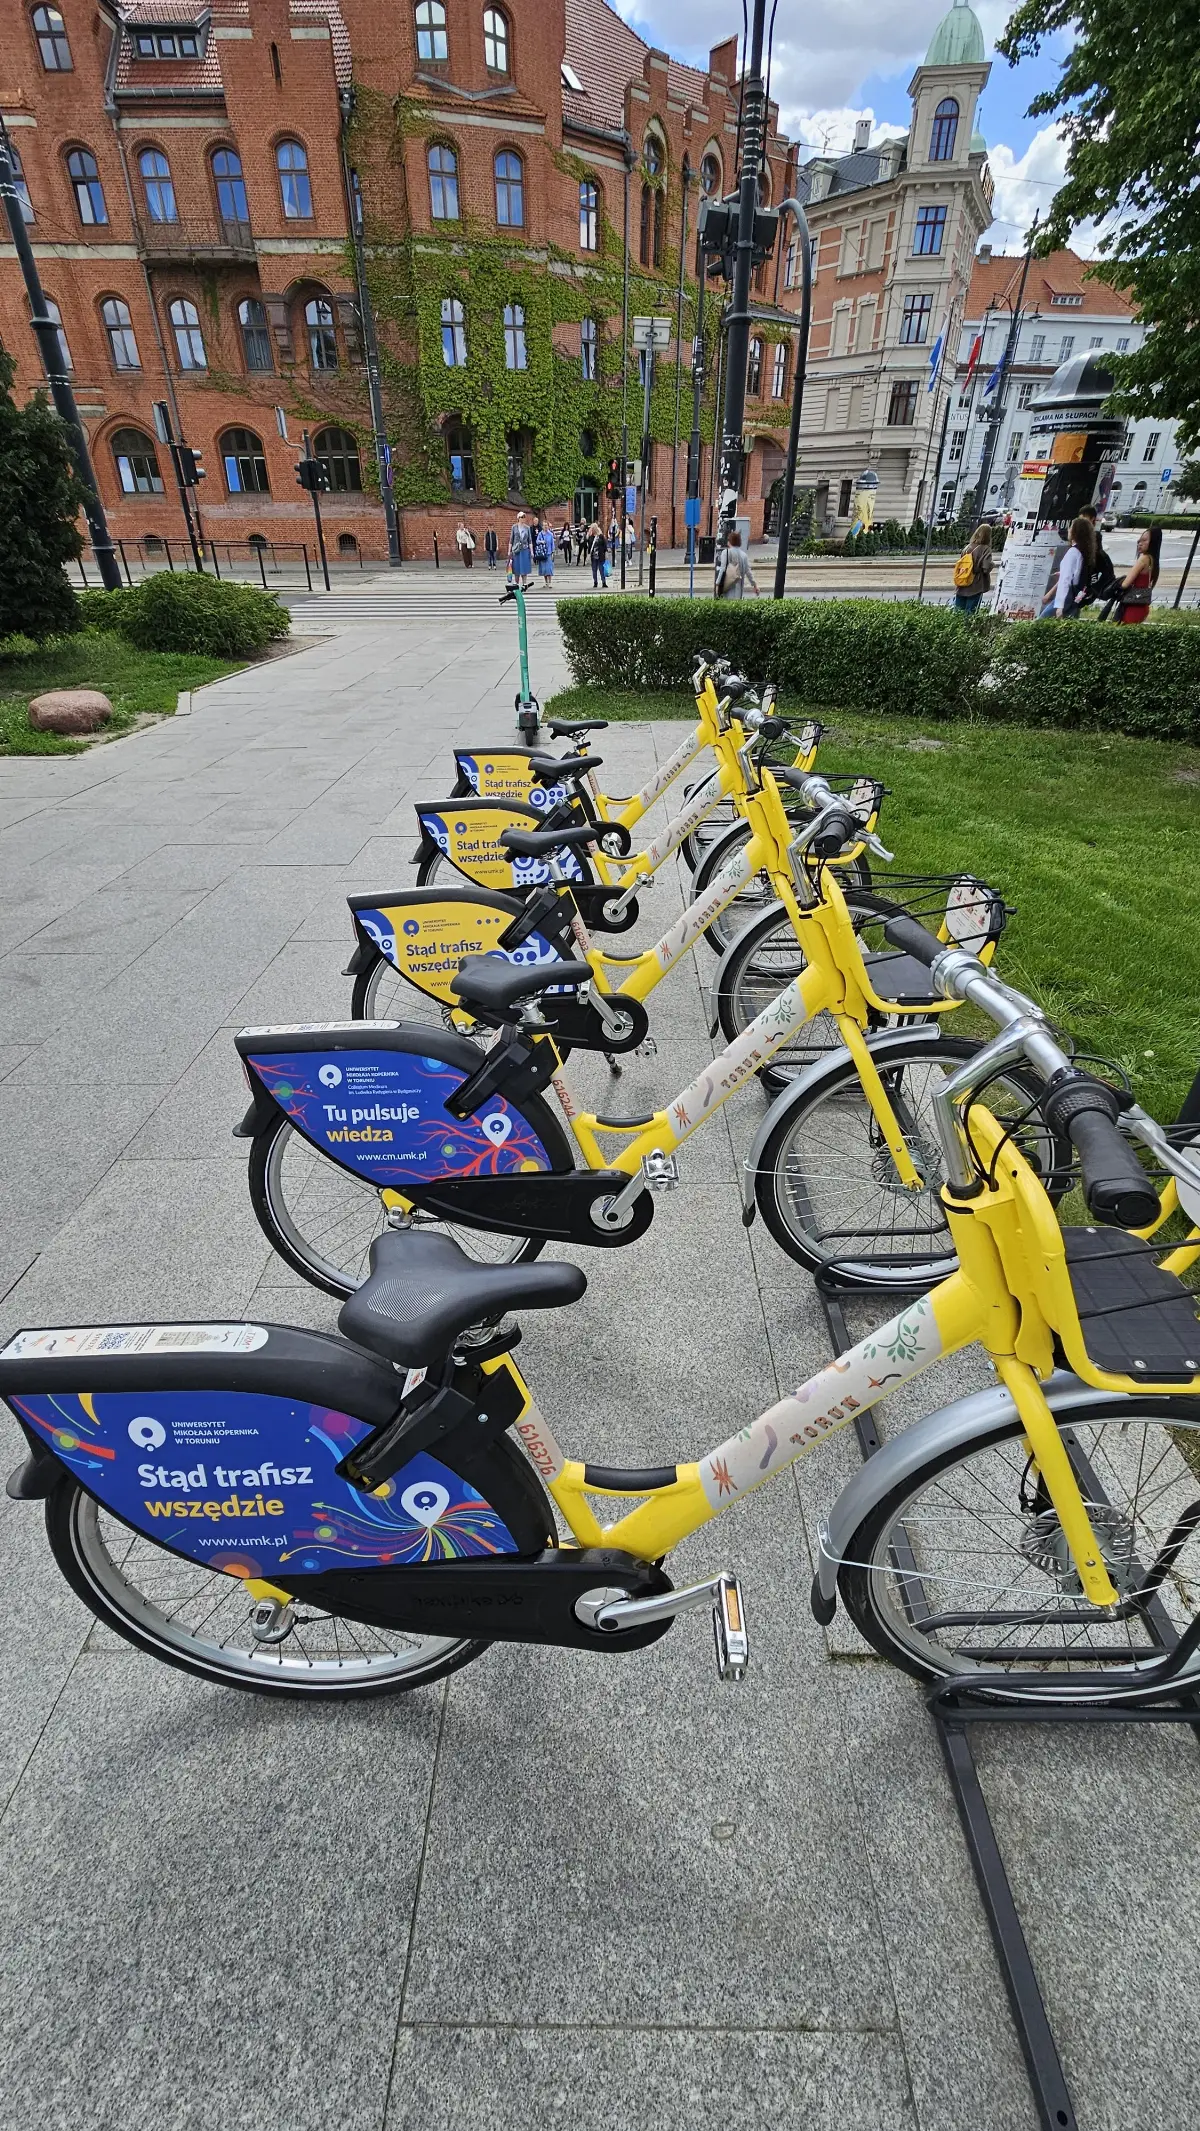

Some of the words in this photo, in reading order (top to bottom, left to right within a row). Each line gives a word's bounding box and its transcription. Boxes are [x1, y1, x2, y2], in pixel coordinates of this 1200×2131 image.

[485, 780, 503, 789] Stąd
[505, 779, 531, 788] trafisz
[456, 840, 480, 851] Stąd
[571, 921, 589, 952] 616293
[405, 942, 437, 957] Stąd
[440, 939, 483, 953] trafisz
[408, 956, 460, 974] wszędzi
[322, 1104, 348, 1122] Tu
[351, 1102, 420, 1125] pulsuje
[326, 1125, 394, 1143] wiedza
[356, 1151, 427, 1162] www.cm.umk.pl
[213, 1428, 259, 1436] KOPERNIKA
[519, 1423, 556, 1477] 616376
[137, 1463, 208, 1493] Stąd
[213, 1462, 314, 1487] trafisz
[144, 1493, 285, 1522] wszędzie
[198, 1535, 288, 1548] www.umk.pl
